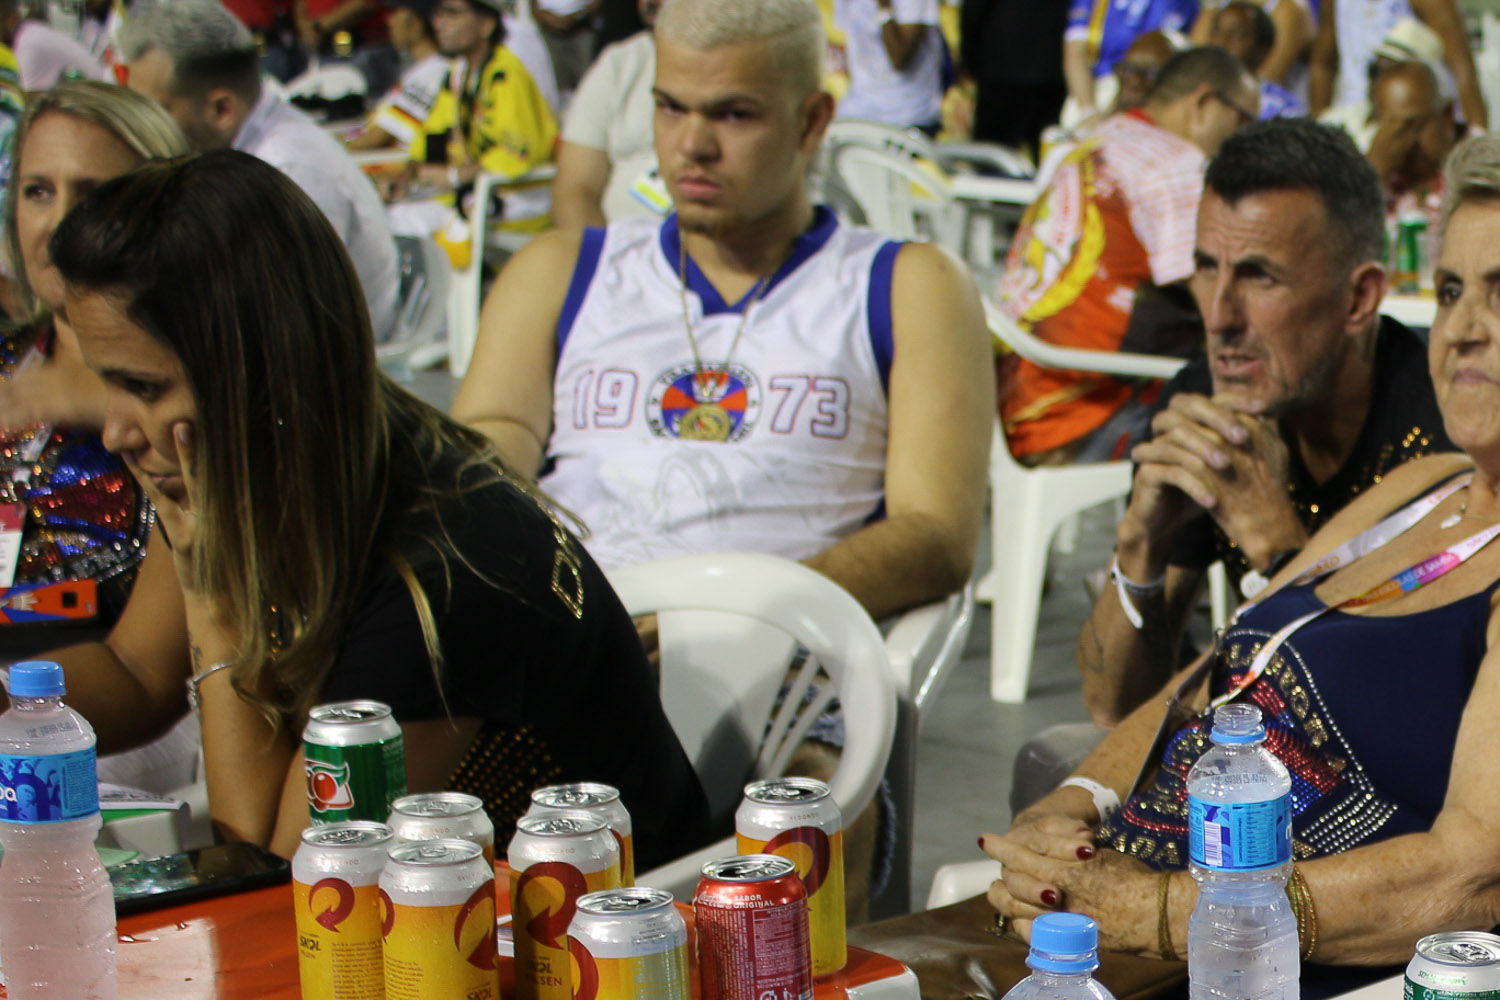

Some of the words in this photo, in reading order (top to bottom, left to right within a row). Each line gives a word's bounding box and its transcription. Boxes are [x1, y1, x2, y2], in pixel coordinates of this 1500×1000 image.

[573, 368, 639, 430] 19
[769, 376, 851, 440] 73
[1413, 566, 1426, 578] DE
[1424, 550, 1458, 573] SAMBA
[733, 900, 775, 909] ORIGINAL
